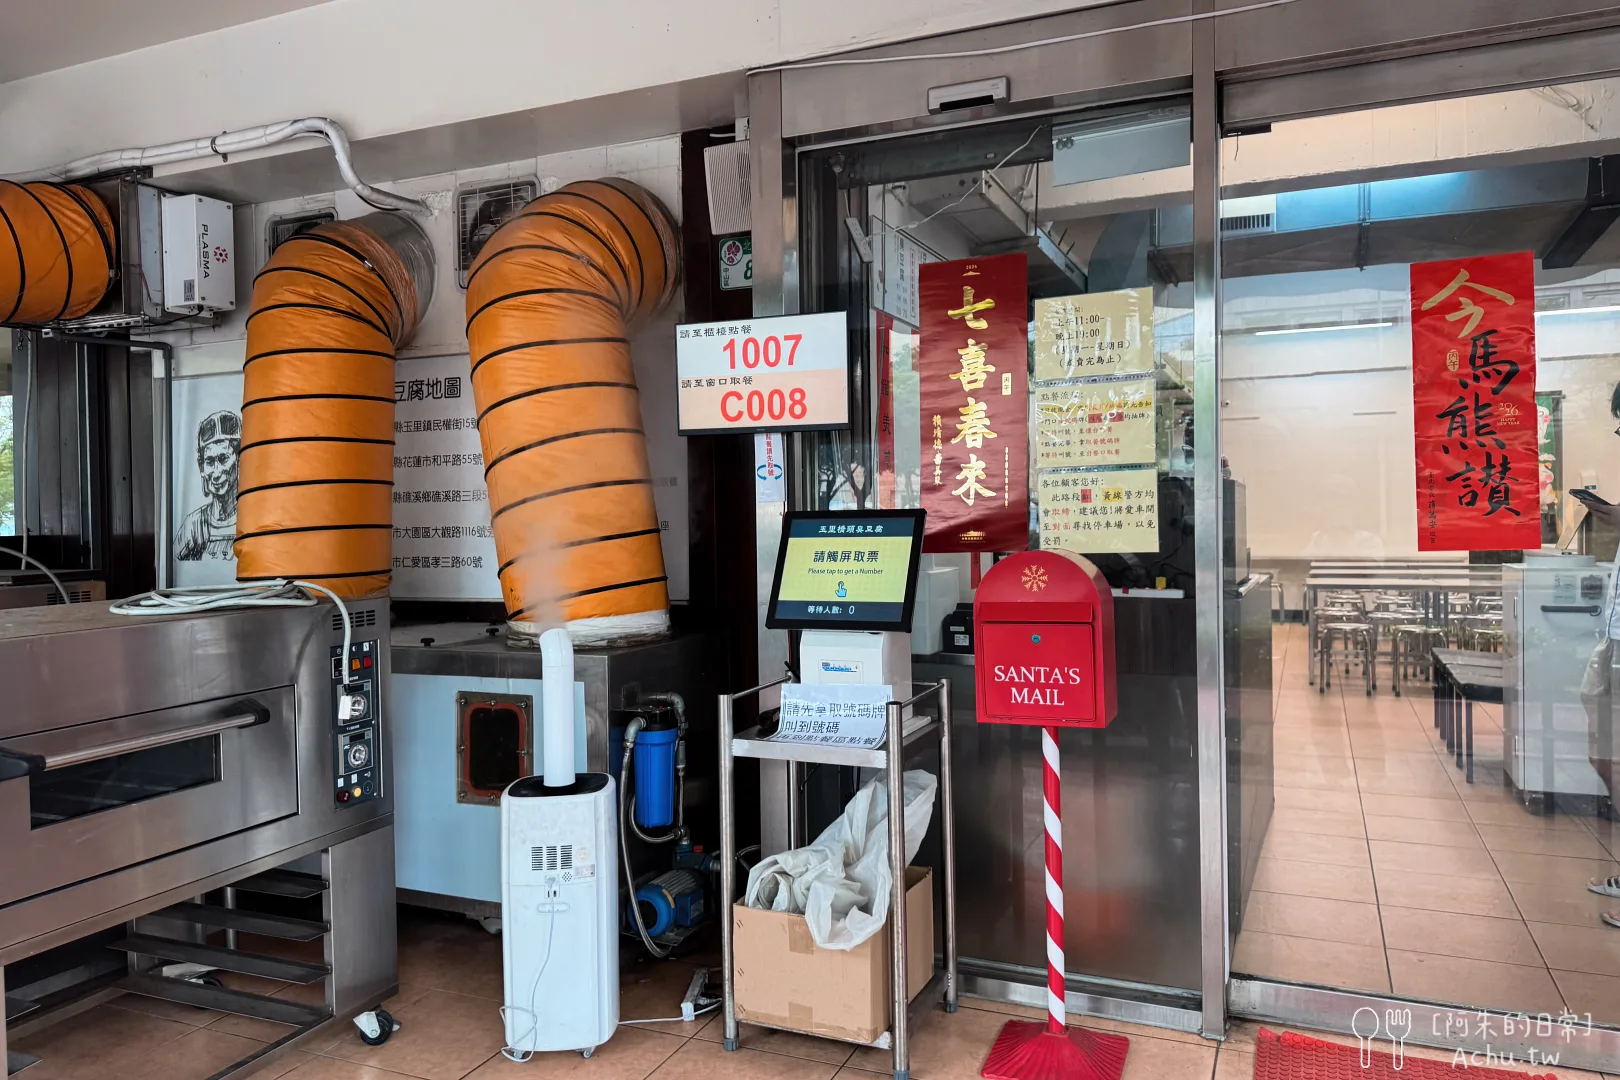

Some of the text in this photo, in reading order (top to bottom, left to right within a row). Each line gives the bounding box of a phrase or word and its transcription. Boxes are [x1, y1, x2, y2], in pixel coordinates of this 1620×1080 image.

[202, 224, 210, 279] PLASMA
[722, 334, 803, 370] 1007
[394, 376, 462, 402] 豆腐地圖
[681, 375, 753, 389] 請至窗口取餐
[720, 387, 808, 423] C008
[818, 524, 884, 534] 玉里橋頭臭豆腐
[813, 550, 880, 563] 請觸屏取票
[827, 568, 837, 576] tap
[844, 568, 854, 576] get
[848, 605, 855, 615] 0
[994, 665, 1081, 685] SANTA'S
[1010, 687, 1065, 706] MAIL
[784, 720, 841, 734] 叫到號碼
